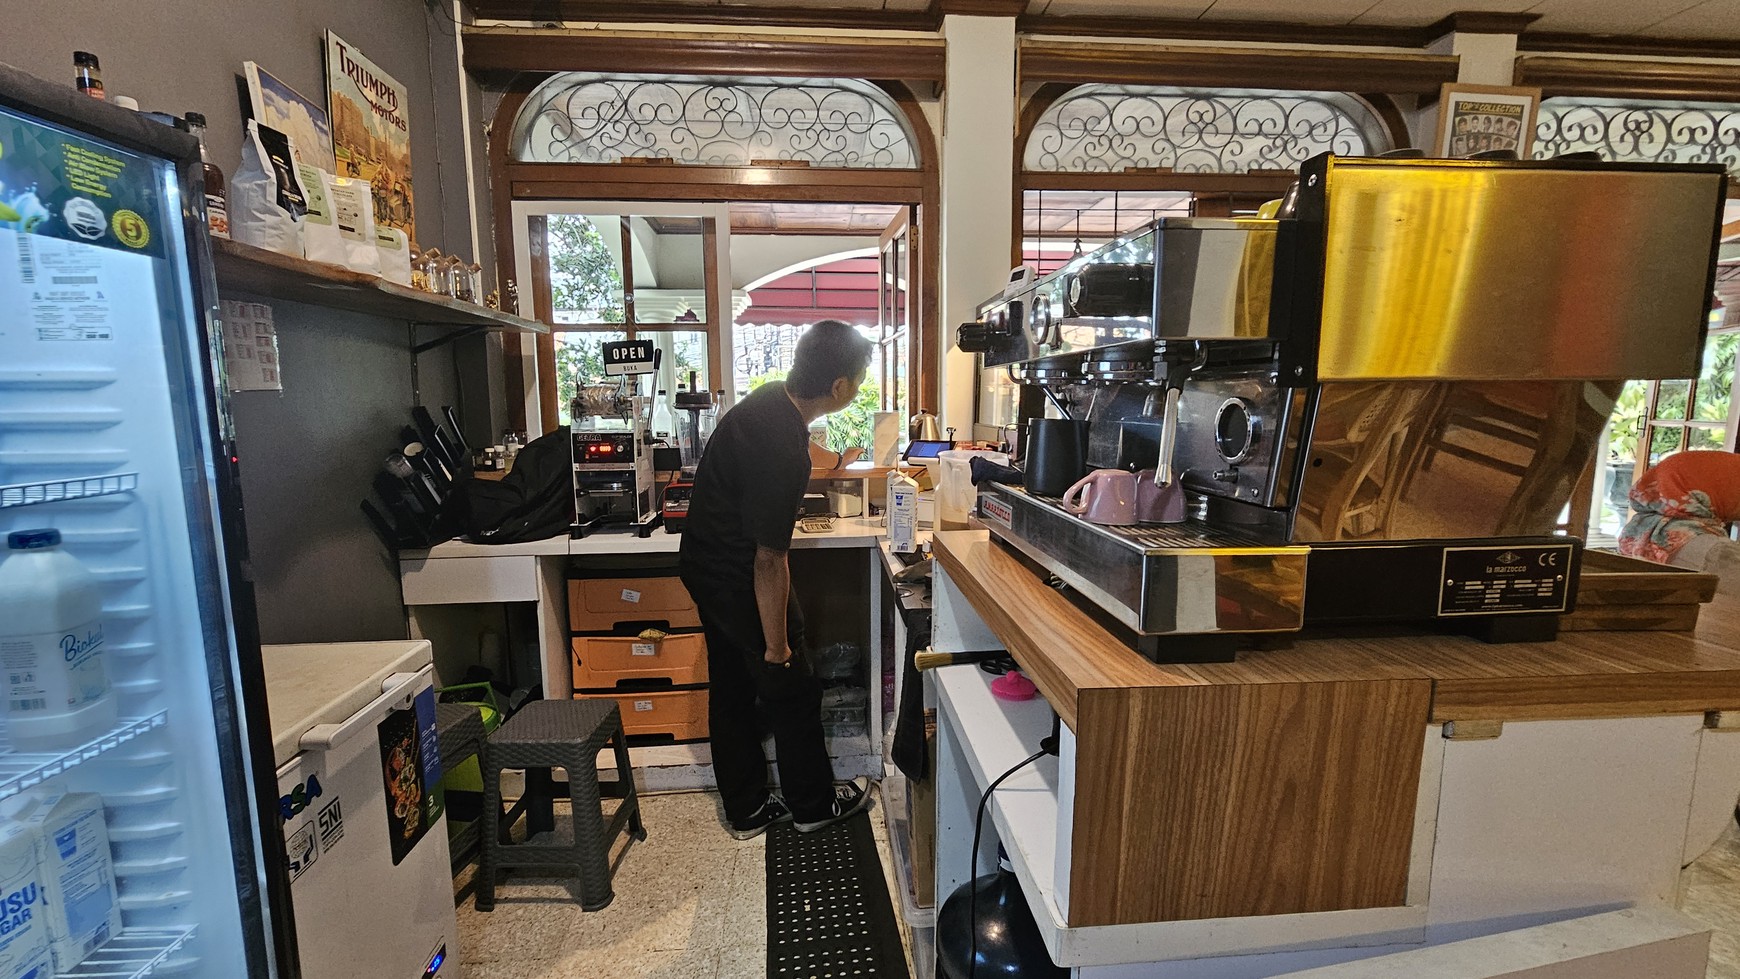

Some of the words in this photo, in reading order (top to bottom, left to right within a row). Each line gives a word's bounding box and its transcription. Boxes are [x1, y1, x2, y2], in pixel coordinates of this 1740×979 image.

[336, 41, 398, 108] TRIUMPH
[1479, 103, 1521, 114] COLLECTION
[370, 100, 407, 132] MOTORS
[612, 346, 645, 360] OPEN
[1538, 552, 1557, 566] CE
[1486, 565, 1492, 573] la
[1493, 565, 1527, 573] marzocco
[319, 800, 342, 836] SNI
